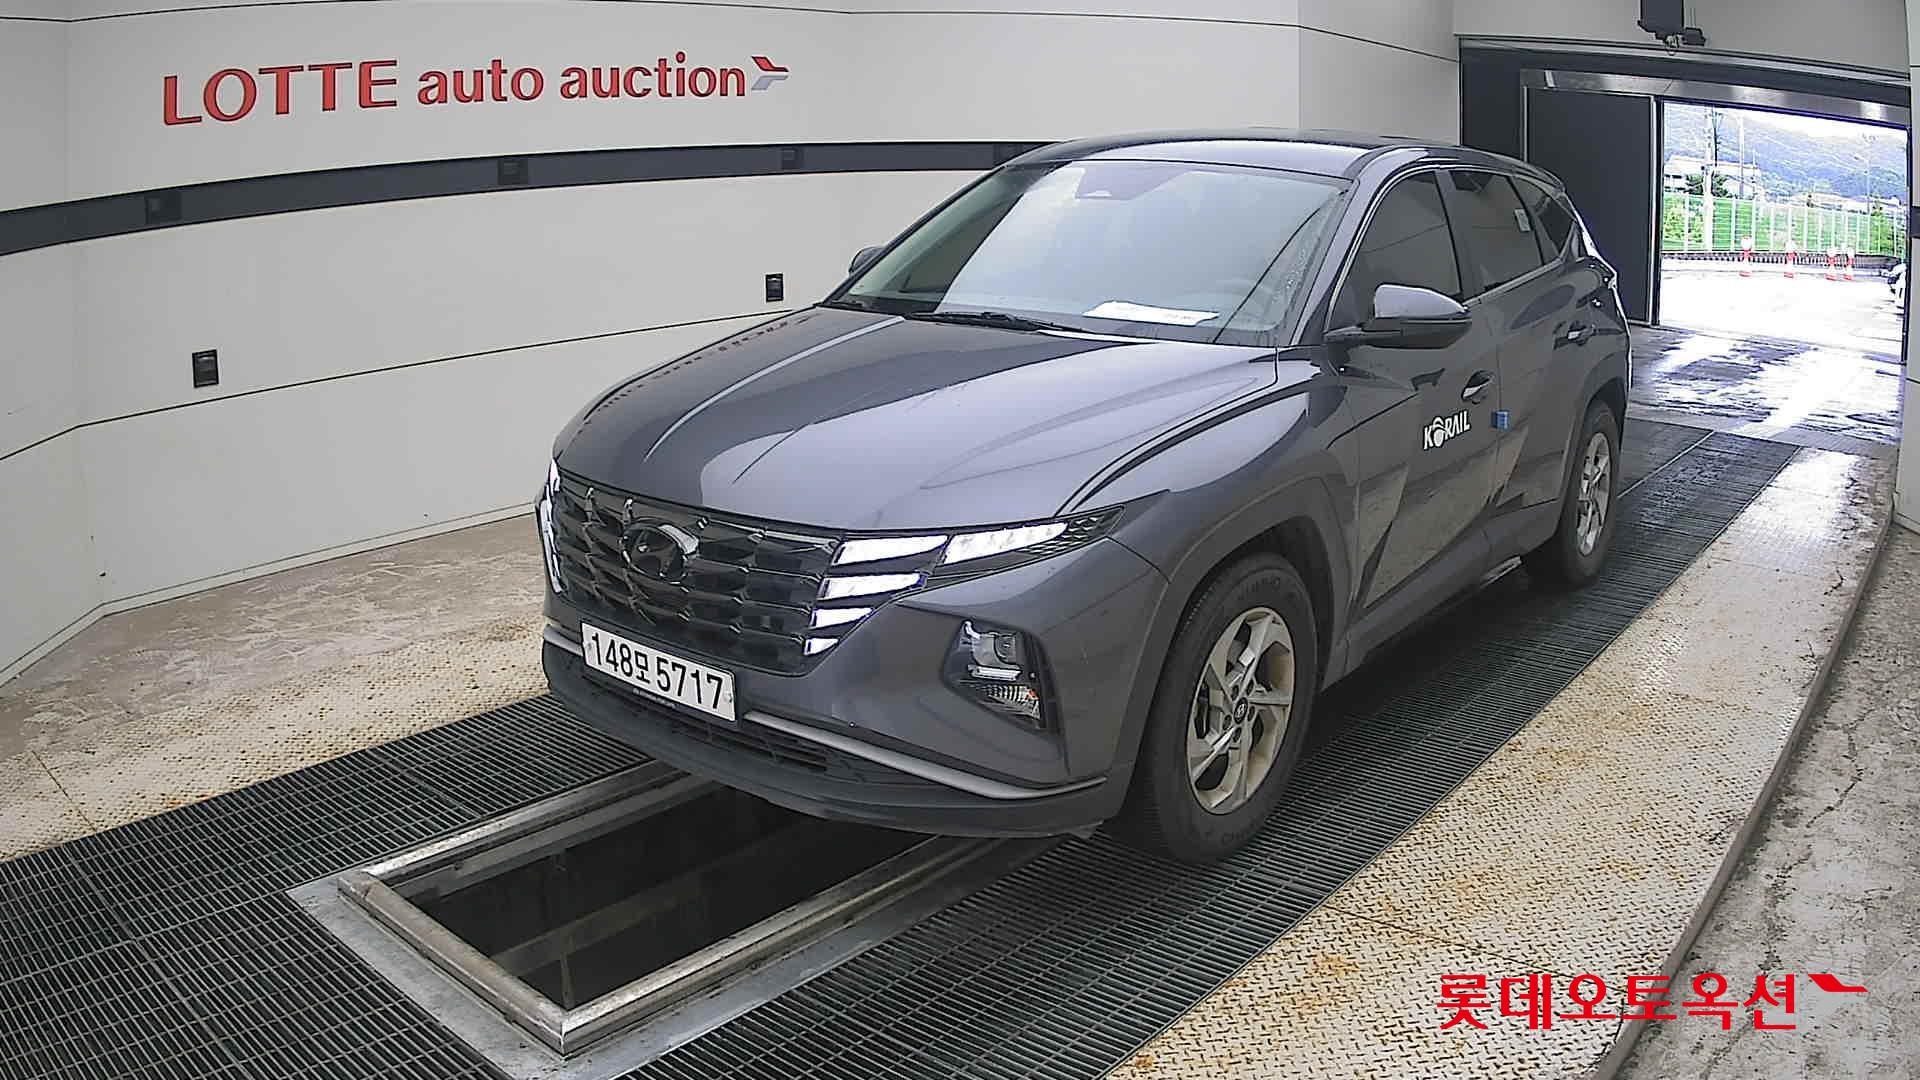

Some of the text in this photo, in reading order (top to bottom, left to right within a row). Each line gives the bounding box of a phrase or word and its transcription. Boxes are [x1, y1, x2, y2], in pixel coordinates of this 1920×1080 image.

[163, 51, 747, 126] LOTTE auto auction
[1423, 410, 1471, 450] KORAIL
